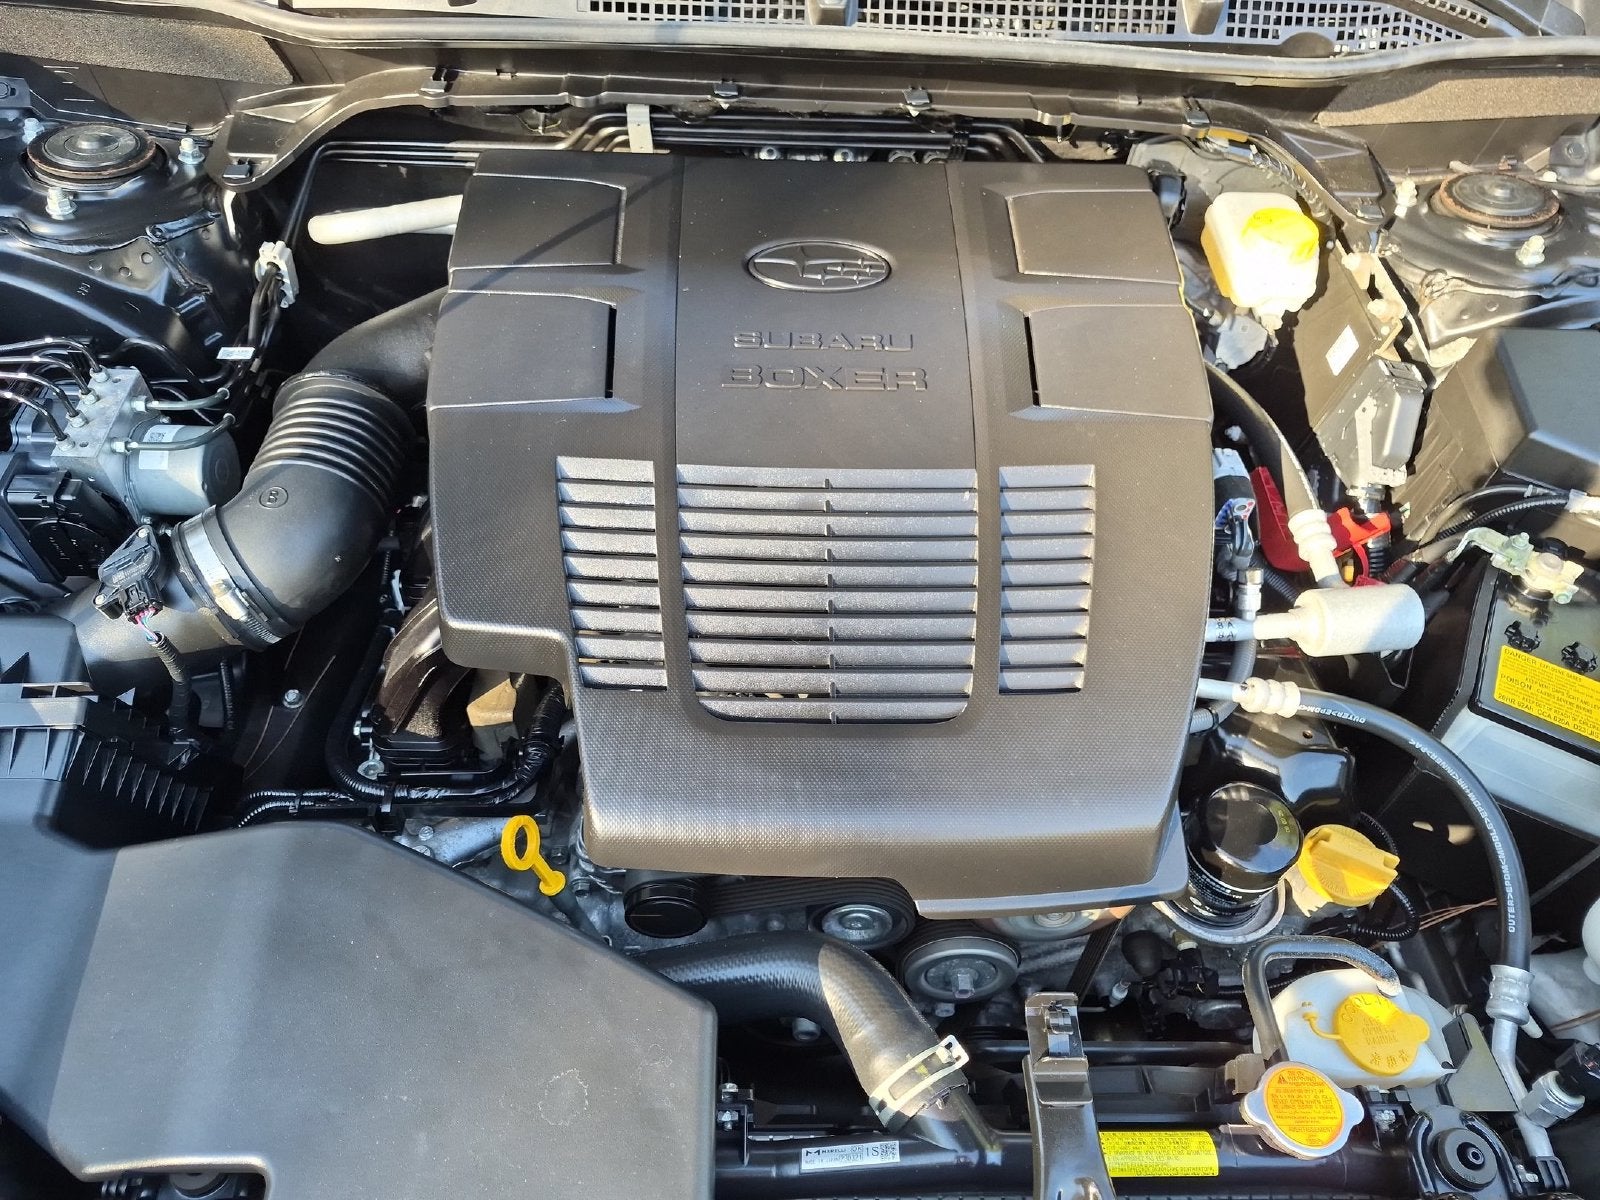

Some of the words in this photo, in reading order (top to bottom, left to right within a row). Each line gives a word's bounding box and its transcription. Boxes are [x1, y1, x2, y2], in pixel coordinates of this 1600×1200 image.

[734, 330, 914, 351] SUBARU
[721, 364, 928, 391] BOXER
[1504, 648, 1537, 665] DANGER
[1500, 674, 1532, 690] POISON
[1537, 709, 1552, 719] CCA
